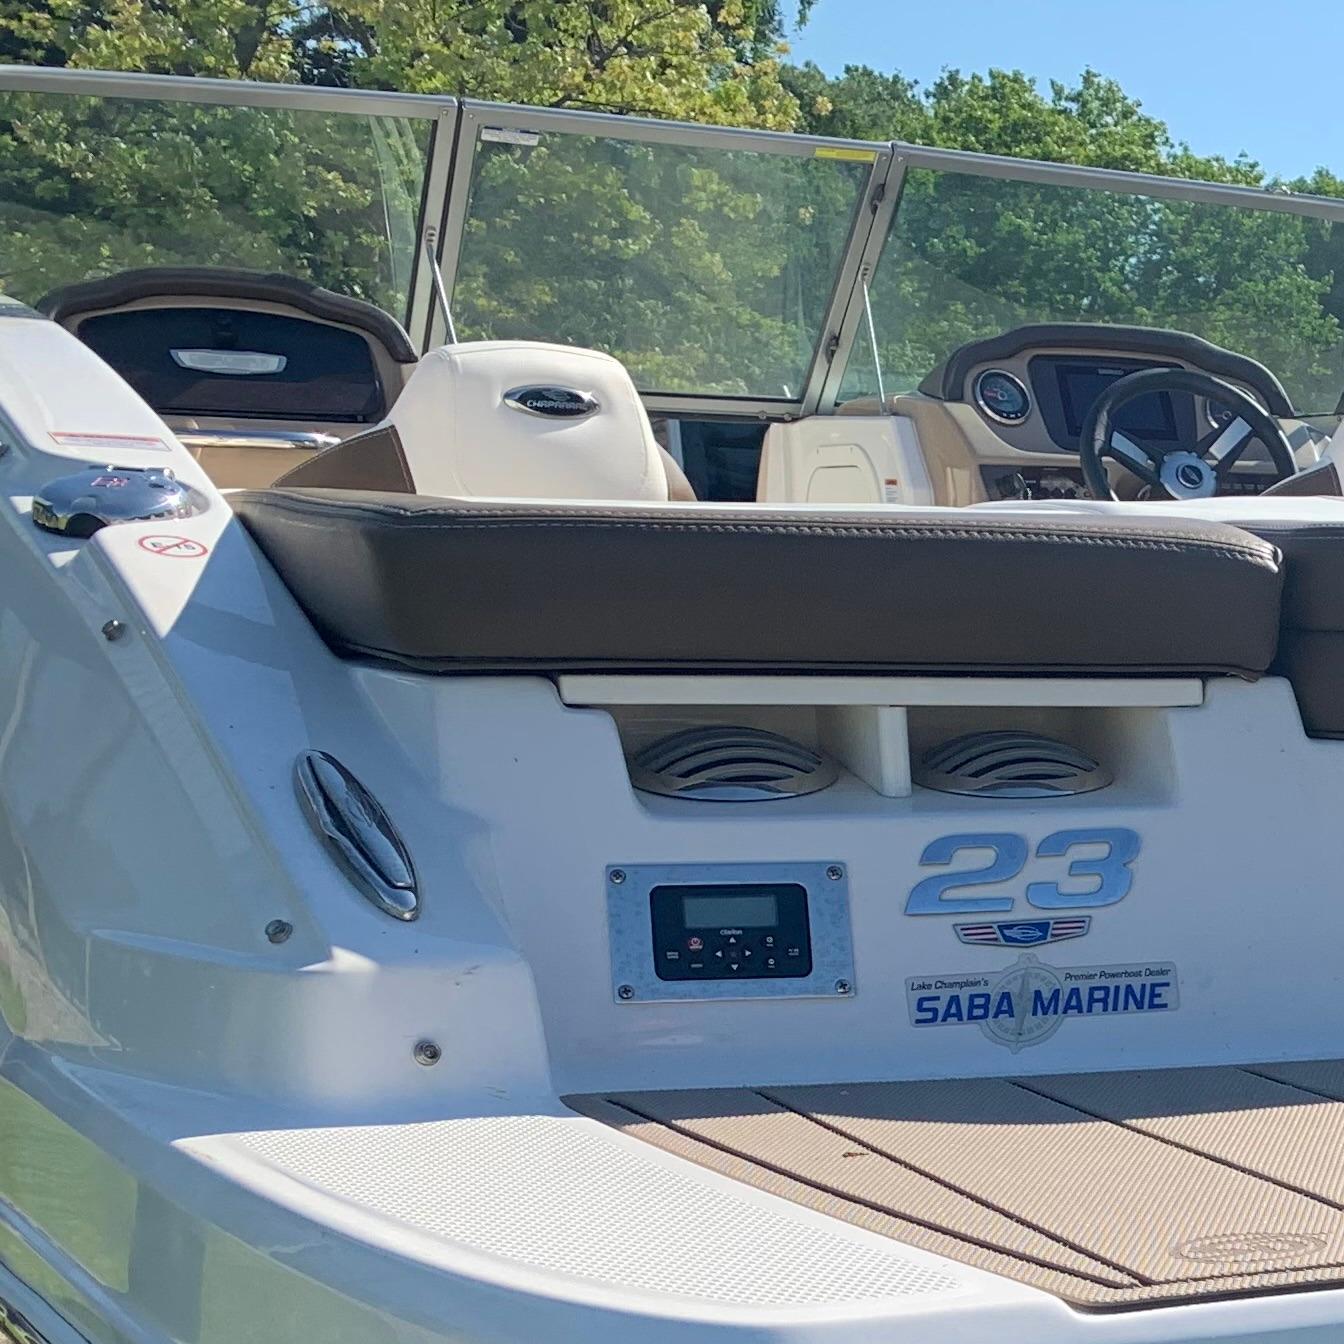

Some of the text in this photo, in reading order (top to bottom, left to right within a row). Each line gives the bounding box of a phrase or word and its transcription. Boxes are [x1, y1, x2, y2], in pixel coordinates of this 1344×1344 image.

[903, 826, 1142, 916] 23
[911, 977, 989, 991] Lake Champlain's
[1064, 967, 1171, 982] Premier Powerboat Dealer
[914, 981, 1171, 1024] SABA MARINE
